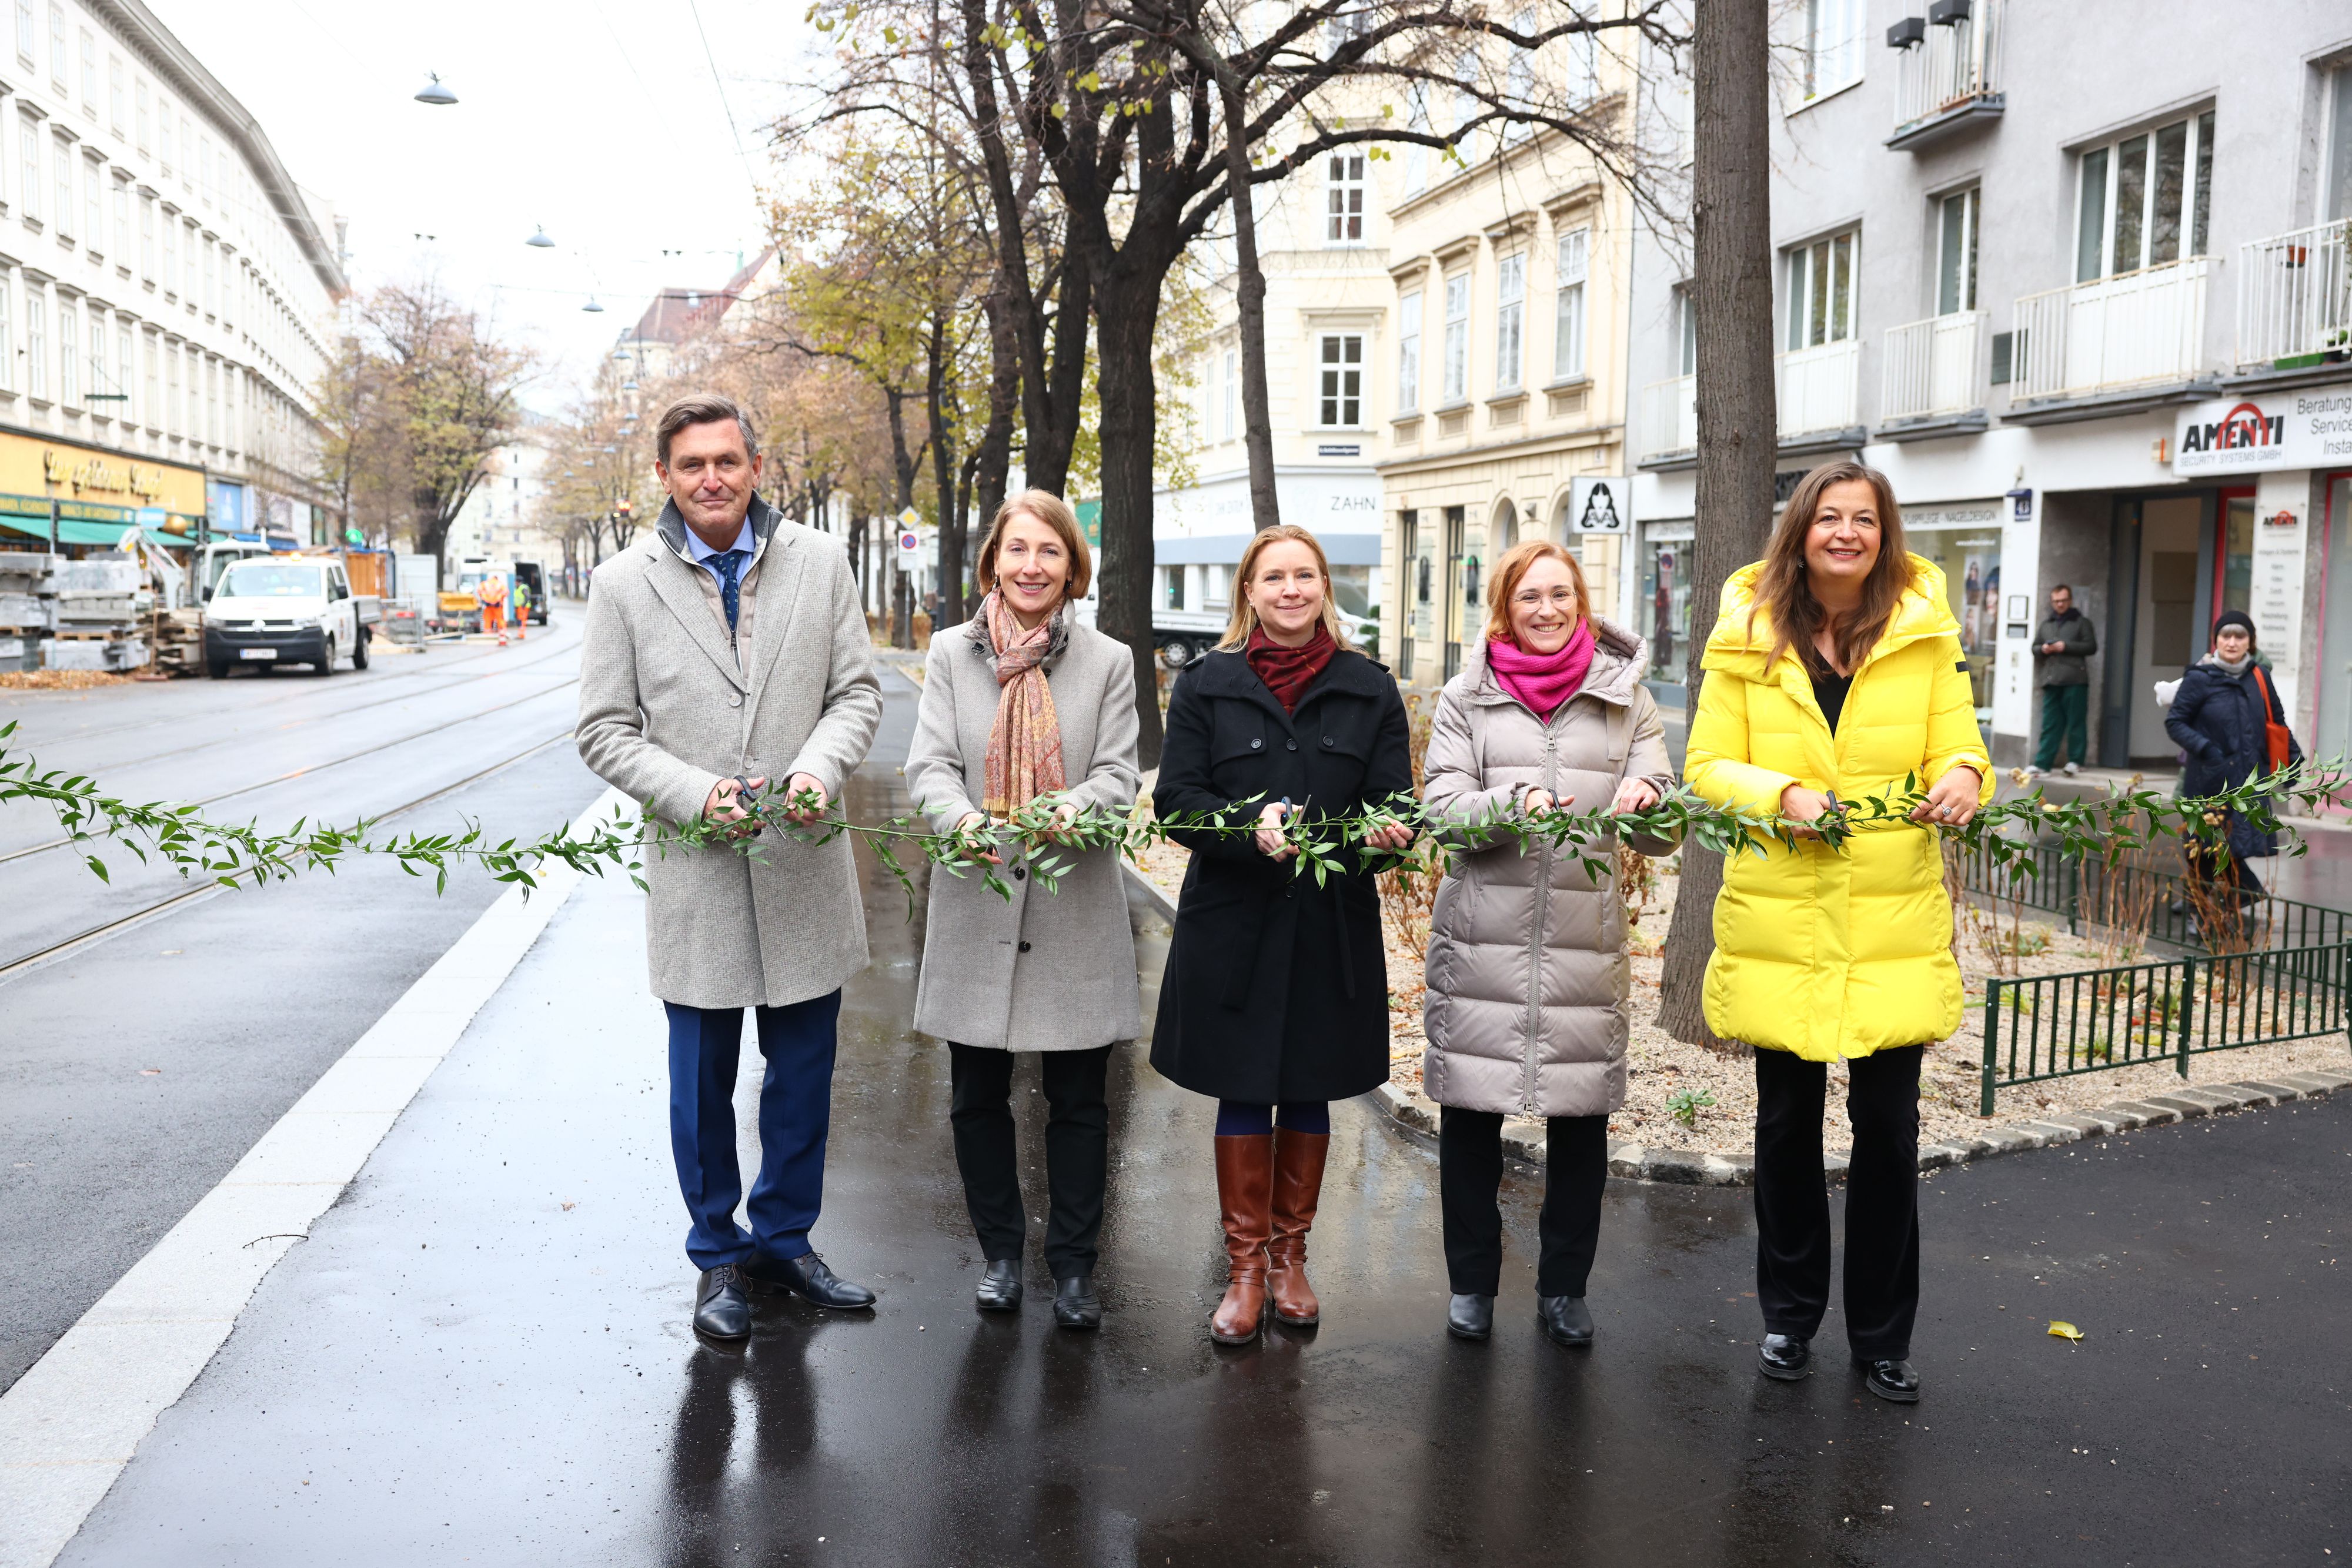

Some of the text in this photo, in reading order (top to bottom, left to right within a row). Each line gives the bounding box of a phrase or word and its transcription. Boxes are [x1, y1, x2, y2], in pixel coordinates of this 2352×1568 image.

[2297, 397, 2352, 414] Beratung
[2181, 402, 2284, 453] AMENTI
[2310, 415, 2352, 434] Service
[2323, 438, 2352, 454] Insta
[2180, 450, 2281, 467] SECURITY SYSTEMS GMBH
[1331, 496, 1375, 510] ZAHN
